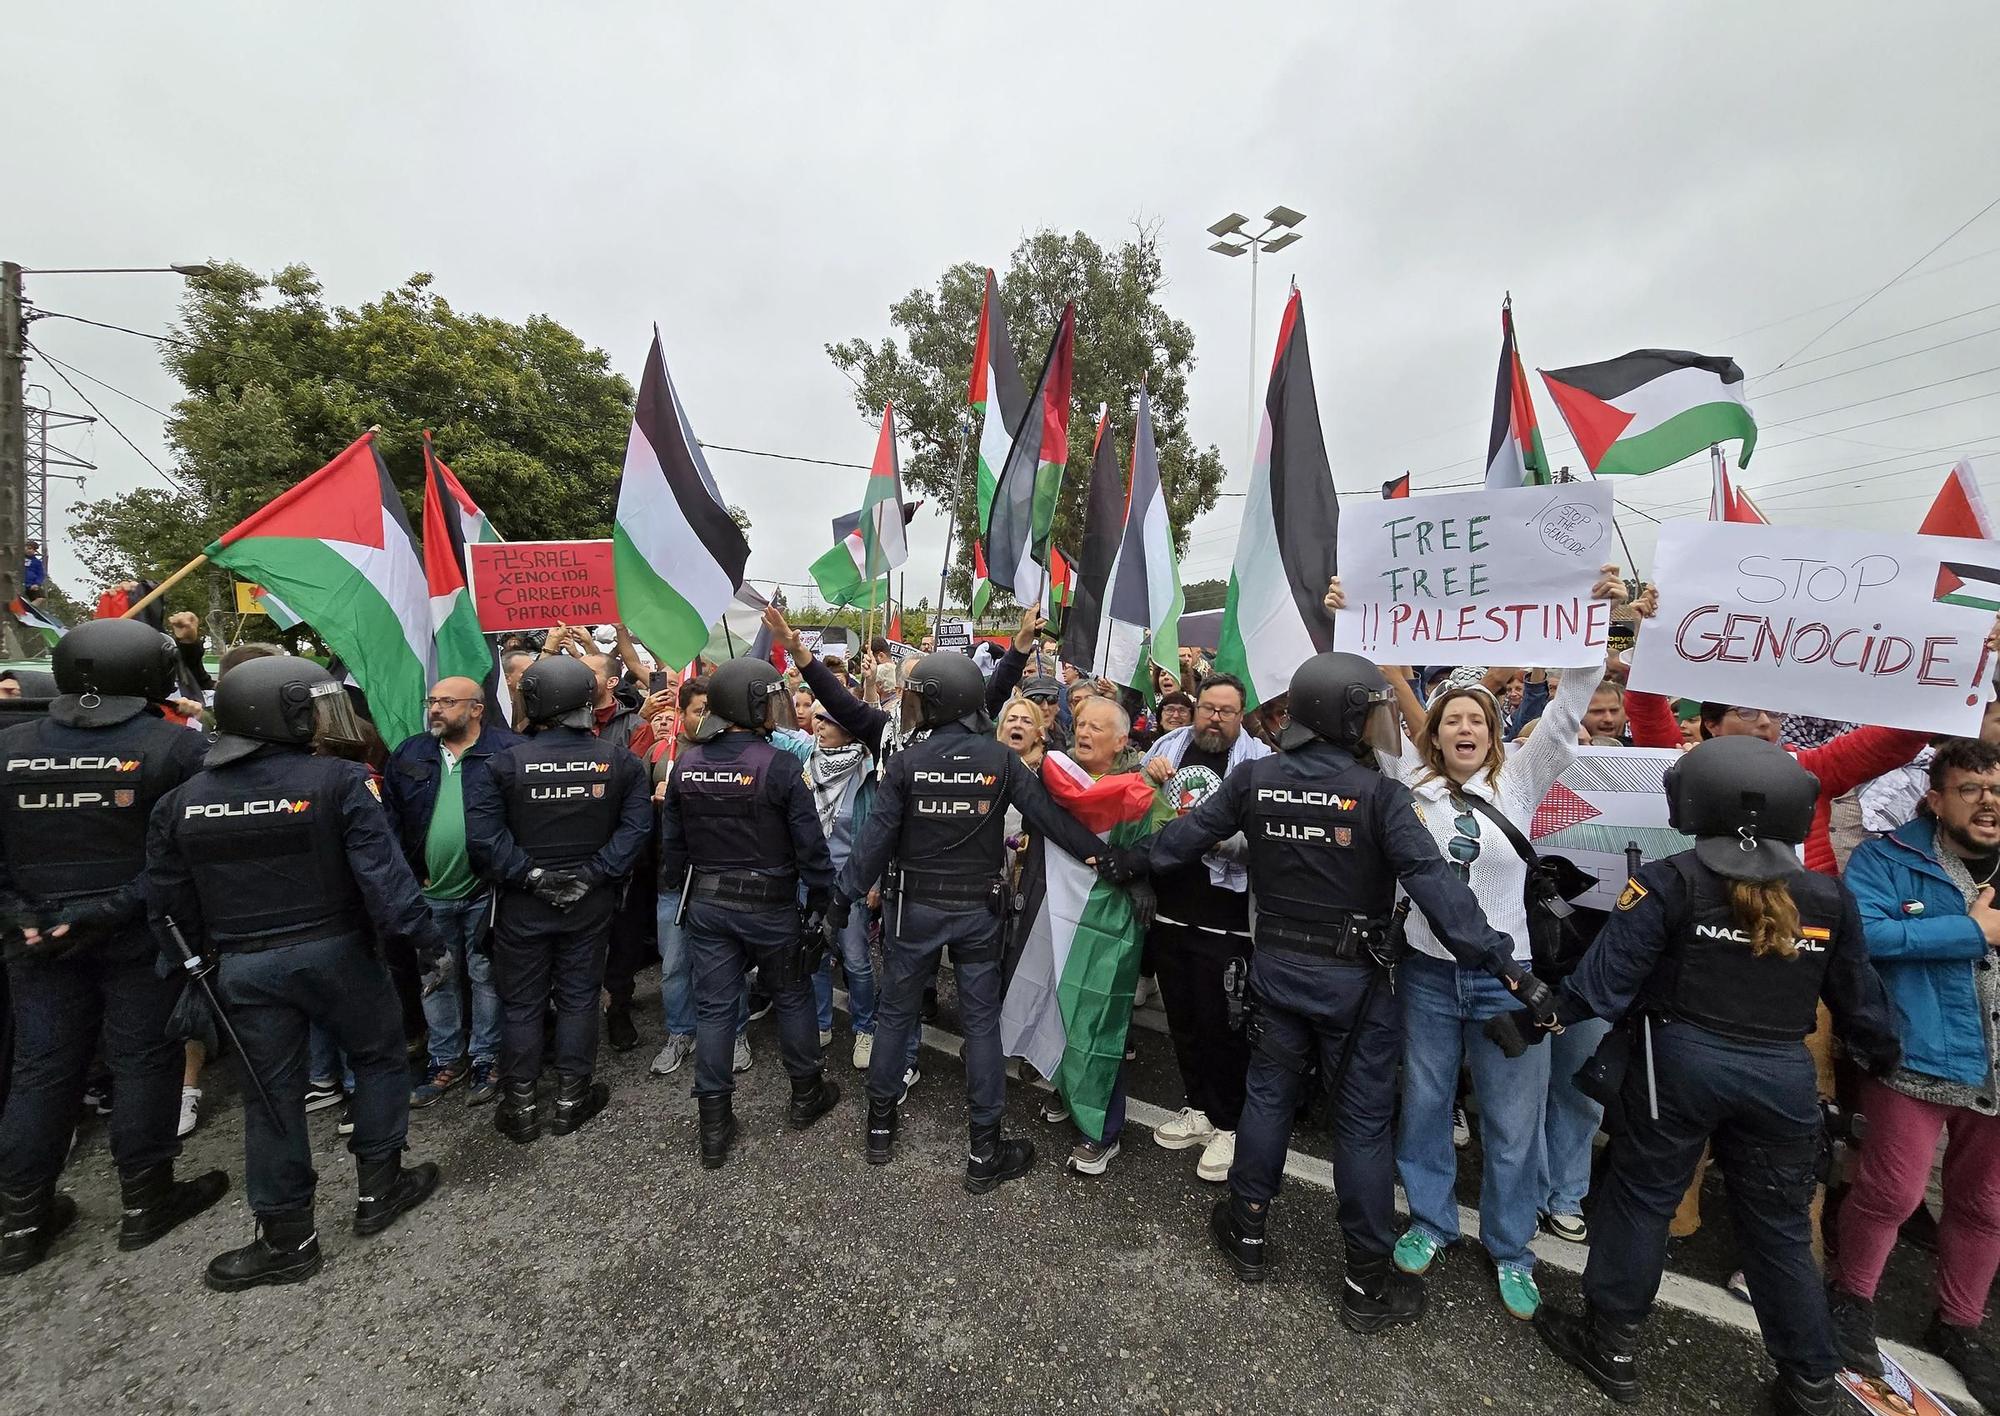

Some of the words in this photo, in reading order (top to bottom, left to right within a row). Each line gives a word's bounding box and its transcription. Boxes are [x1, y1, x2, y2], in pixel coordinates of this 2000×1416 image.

[1557, 515, 1577, 532] THE
[1561, 505, 1592, 525] STOP
[1382, 515, 1491, 558] FREE
[1543, 522, 1586, 557] GENOCIDE
[499, 568, 588, 585] XENOCIDA
[1379, 562, 1491, 602] FREE
[1737, 554, 1900, 603] STOP
[495, 585, 601, 606] CARREFOUR
[6, 757, 122, 772] POLICIA
[525, 761, 599, 773] POLICIA
[681, 771, 743, 785] POLICIA
[914, 771, 985, 785] POLICIA
[18, 792, 109, 808] U.I.P.
[531, 786, 590, 799] U.I.P.
[1258, 789, 1342, 809] POLICIA
[185, 798, 294, 819] POLICIA
[918, 800, 975, 814] U.I.P.
[1266, 822, 1331, 843] U.I.P.
[1695, 924, 1826, 952] NACAL
